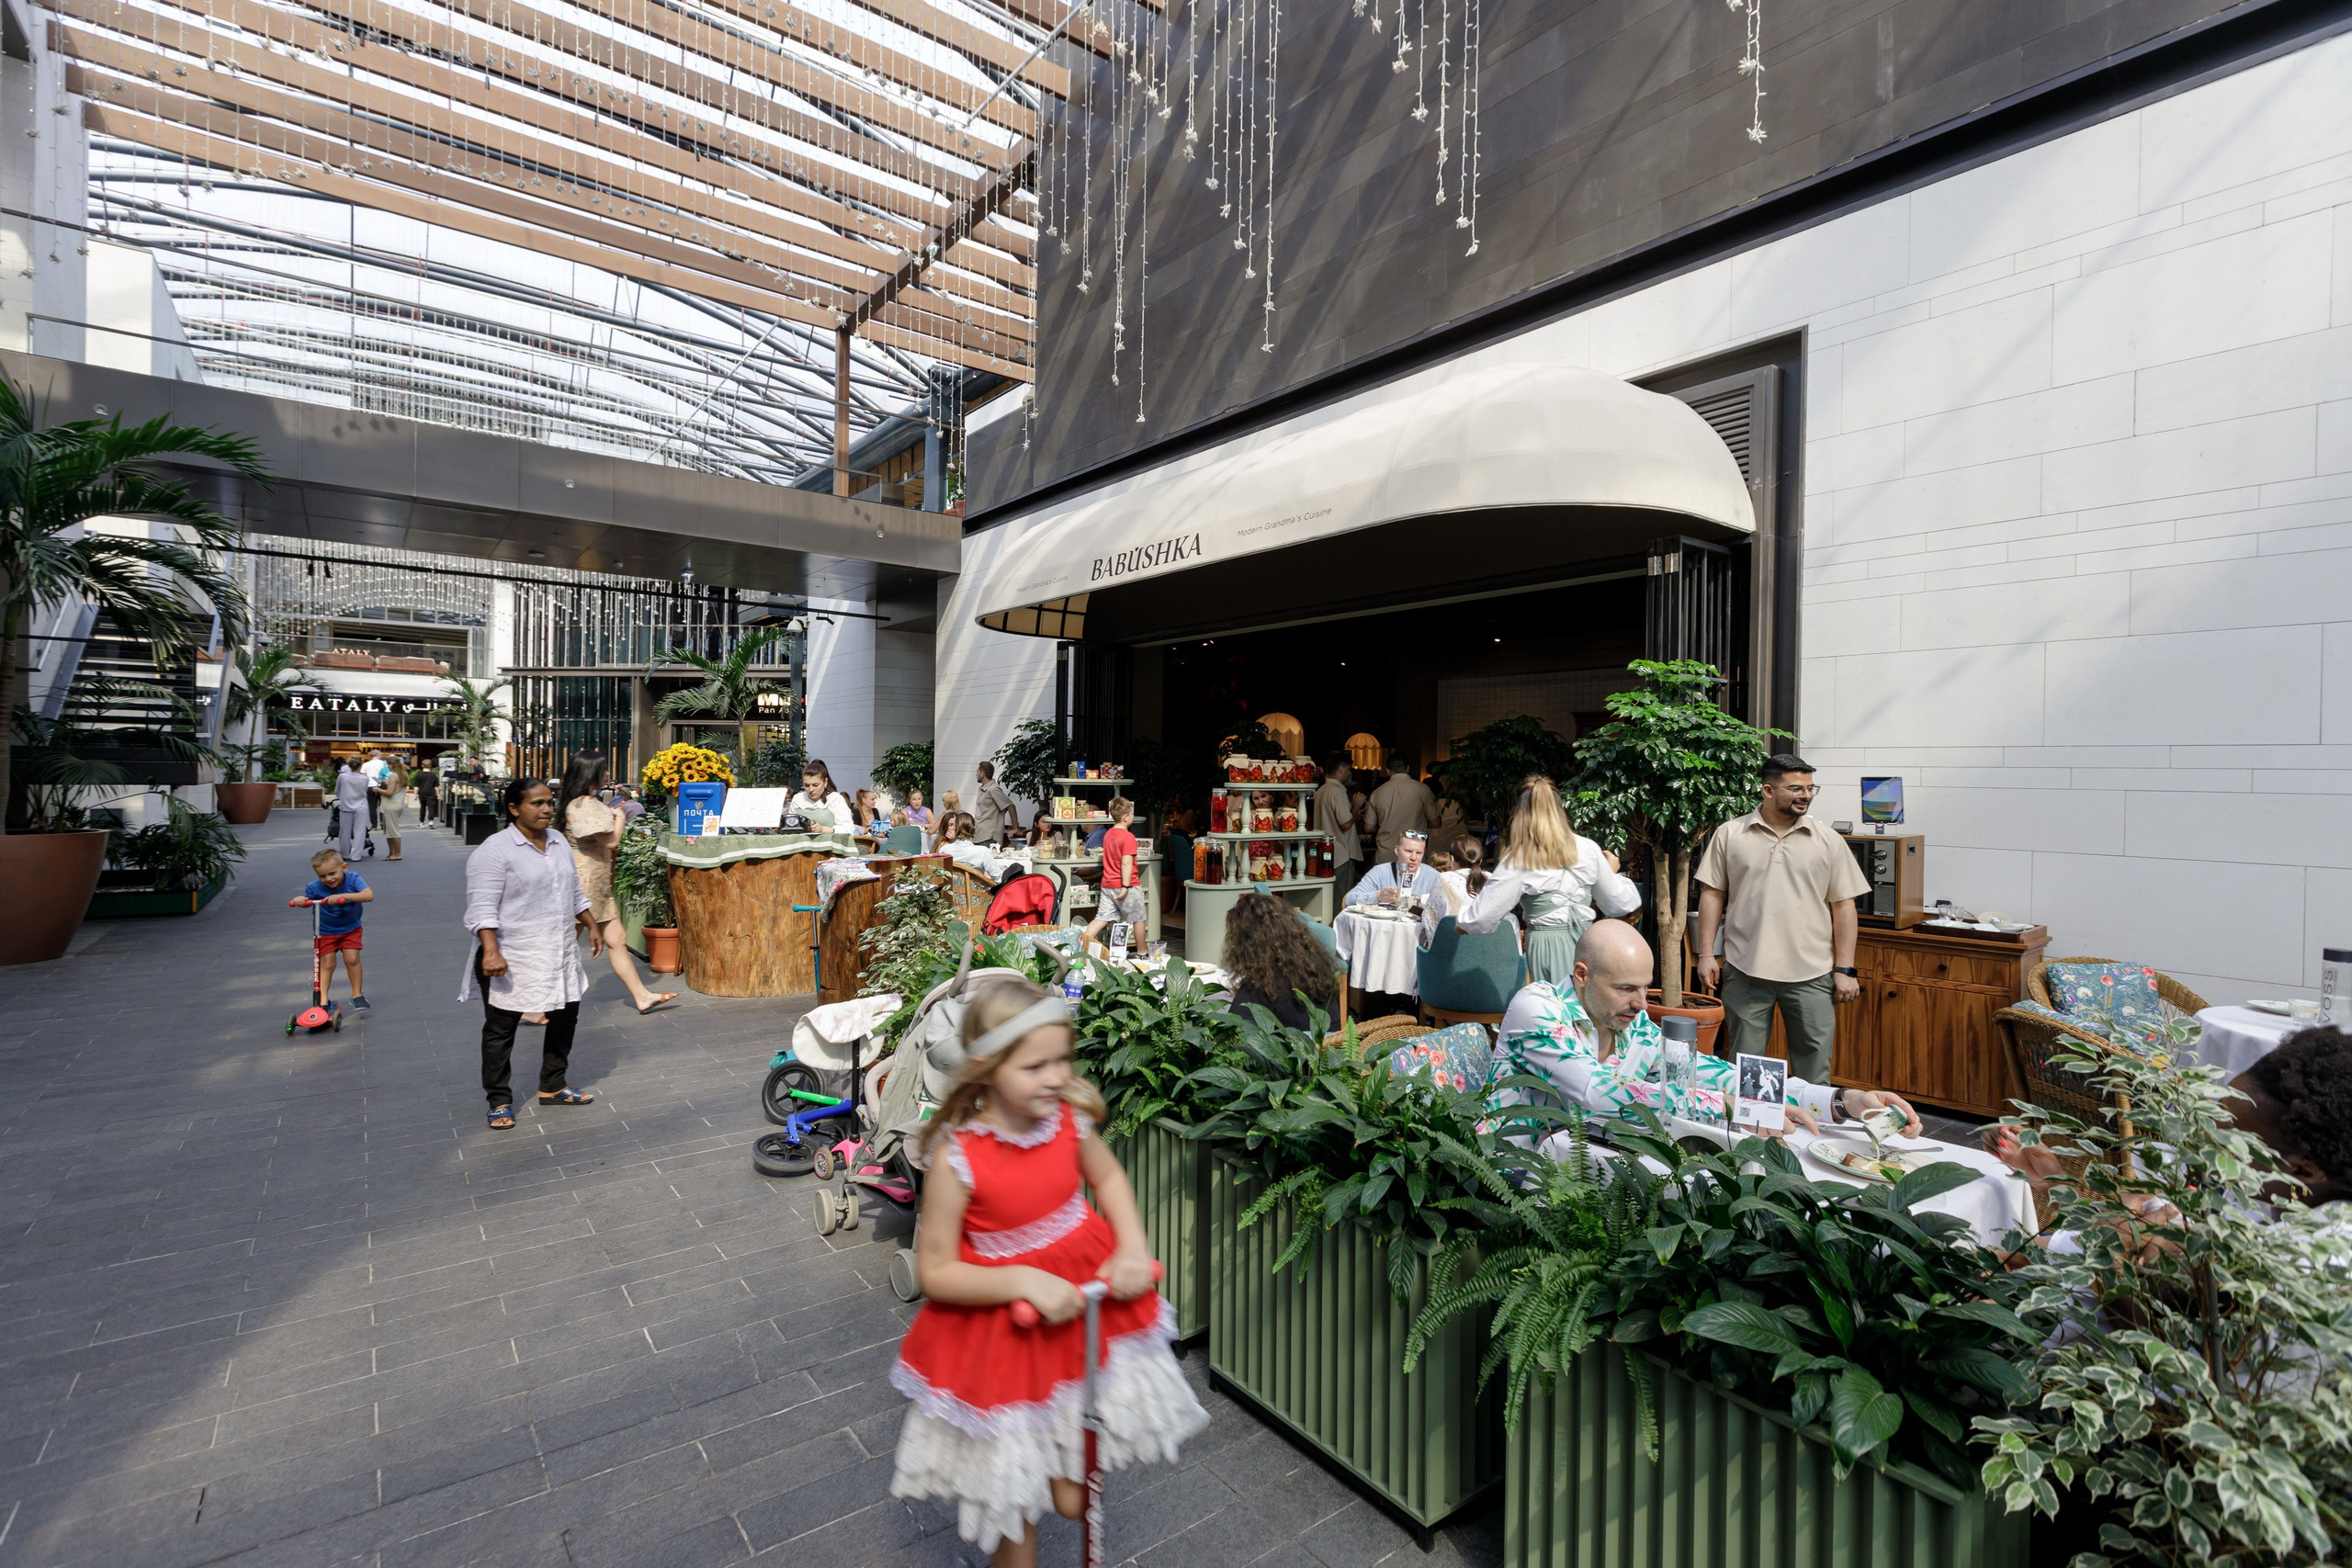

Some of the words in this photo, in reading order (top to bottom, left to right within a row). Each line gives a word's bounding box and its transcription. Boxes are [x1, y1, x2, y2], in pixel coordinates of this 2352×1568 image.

[1237, 525, 1262, 537] Modern
[1264, 514, 1302, 531] Grandma's
[1304, 507, 1332, 521] Cuisine
[290, 696, 396, 713] EATALY
[2323, 970, 2334, 1023] VOSS
